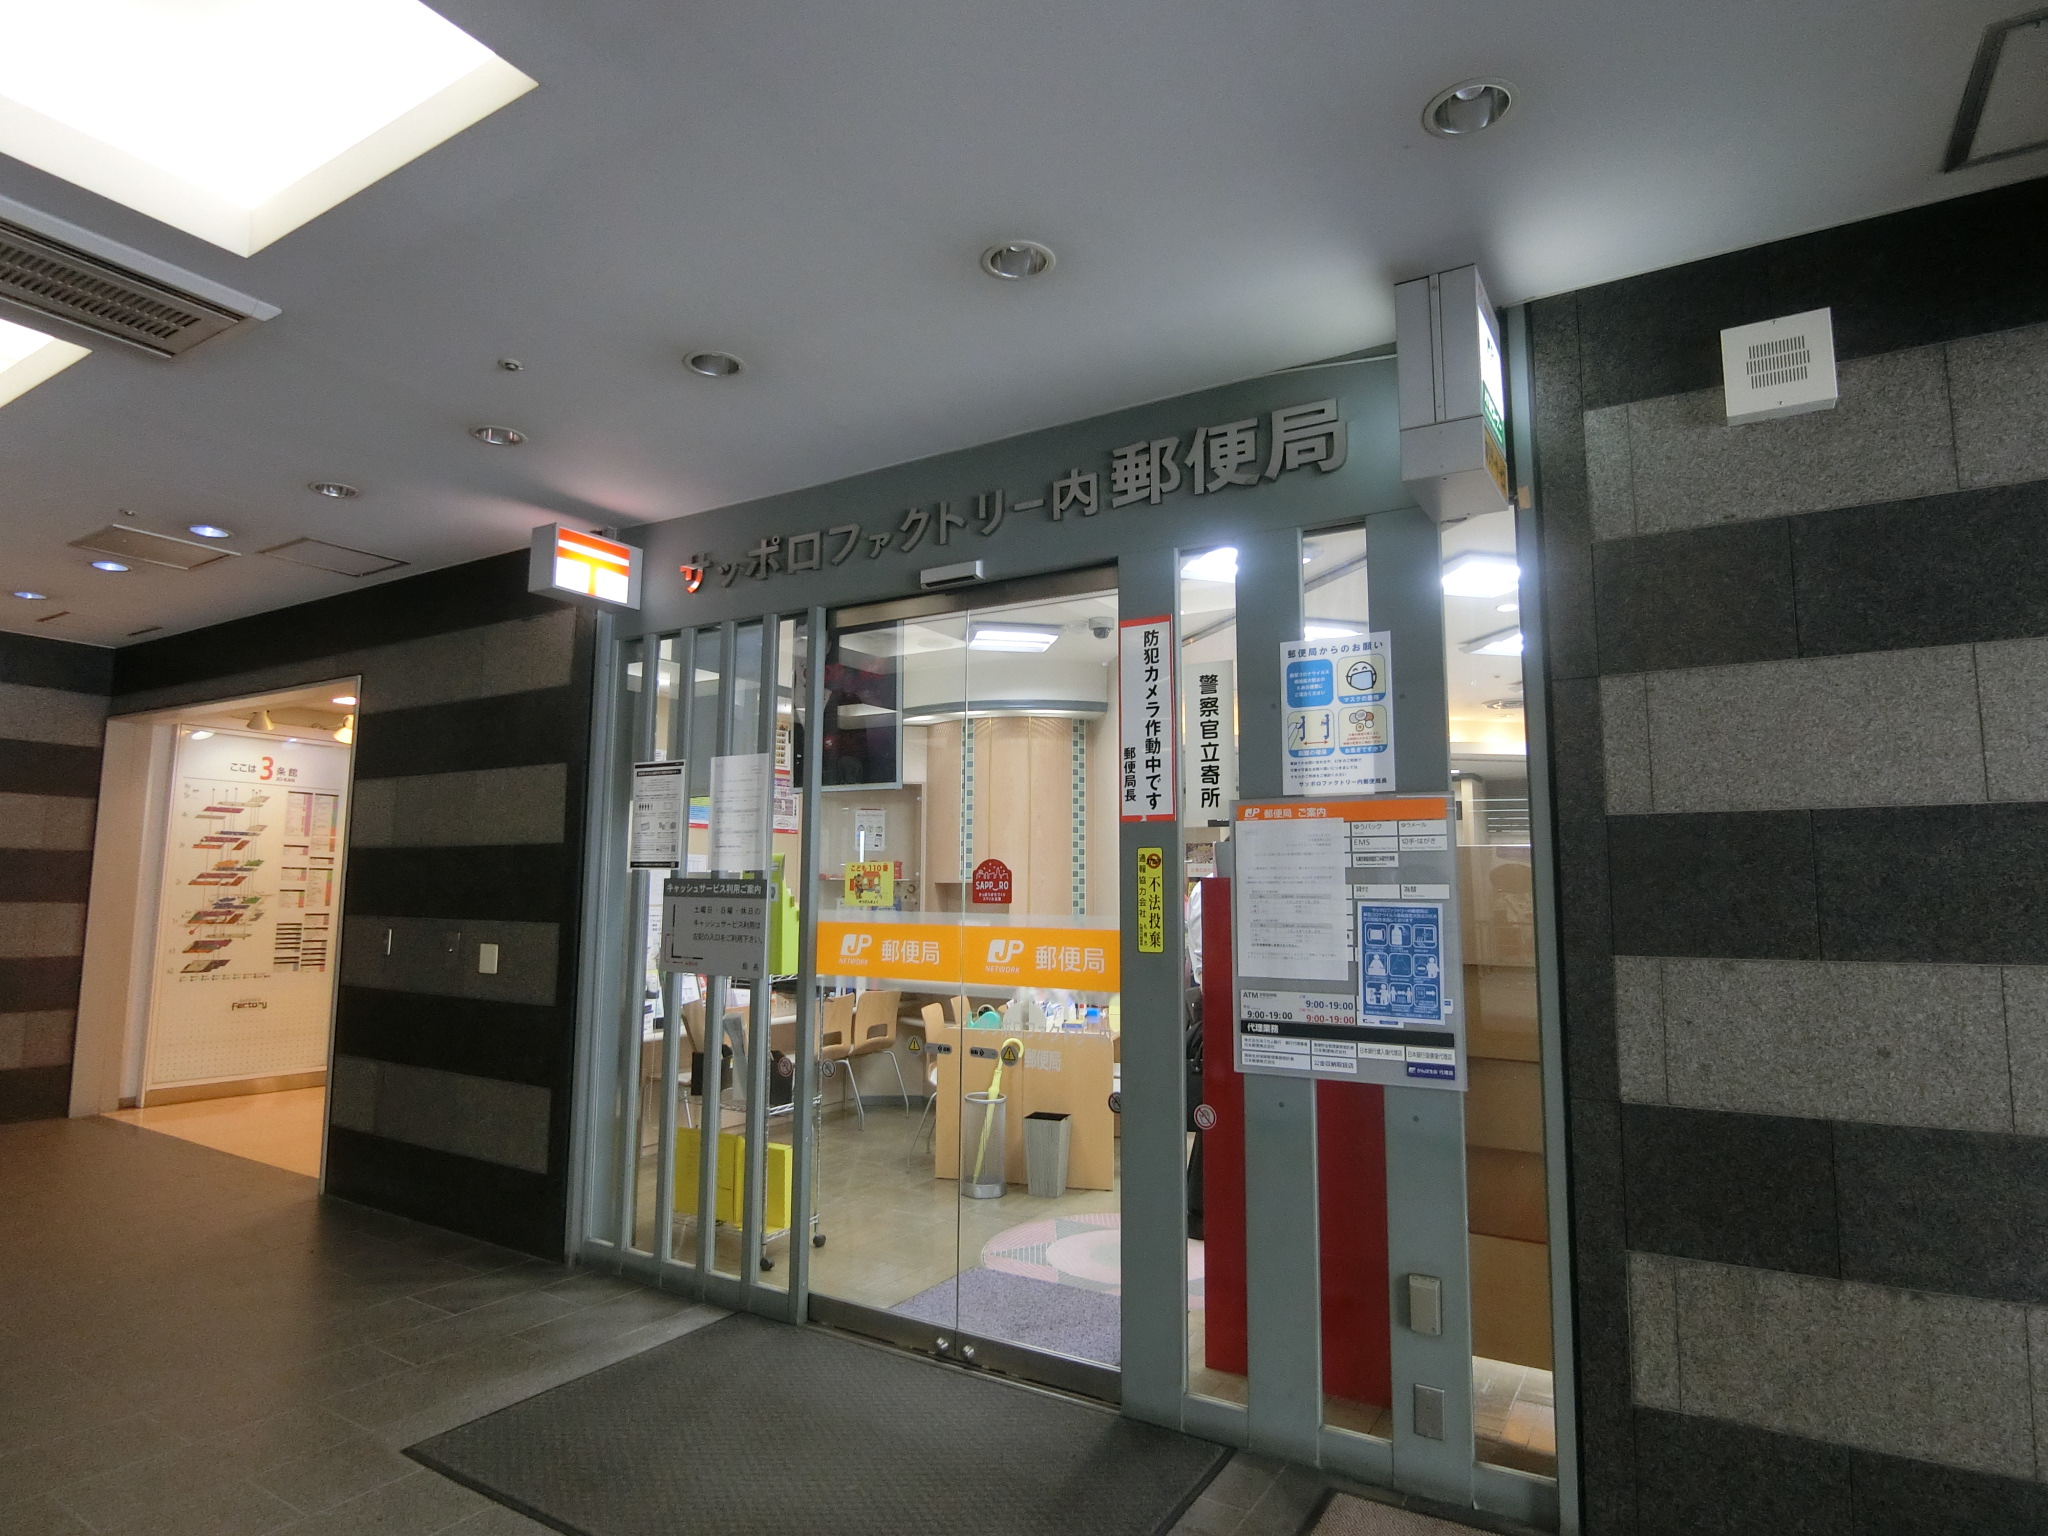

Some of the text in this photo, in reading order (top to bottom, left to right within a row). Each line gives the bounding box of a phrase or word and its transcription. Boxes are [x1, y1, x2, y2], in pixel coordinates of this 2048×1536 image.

[680, 399, 1349, 594] サッポロファクトリー内郵便局
[1287, 641, 1383, 659] 郵便局からのお願い
[1143, 629, 1162, 810] 防犯カメラ作動中です
[1199, 674, 1220, 808] 警察官立寄所
[230, 756, 298, 780] ここは 3 条館
[1124, 747, 1137, 802] 郵便局長
[1264, 808, 1292, 818] 郵便局
[1298, 807, 1327, 818] ご案内
[1354, 838, 1370, 846] EMS
[667, 883, 762, 895] キャッシュサービス利用ご案内
[1149, 876, 1161, 947] 不法投棄
[838, 958, 869, 966] NETWORK
[881, 940, 940, 966] 郵便局
[1035, 945, 1105, 974] 郵便局
[985, 965, 1020, 974] NETWORK
[1305, 1000, 1354, 1010] 9:00-19:00
[1247, 1011, 1293, 1020] 9:00-19:00
[1306, 1014, 1355, 1024] 9:00-19:00
[1247, 1023, 1279, 1034] 代理業務
[1023, 1048, 1061, 1072] 郵便局
